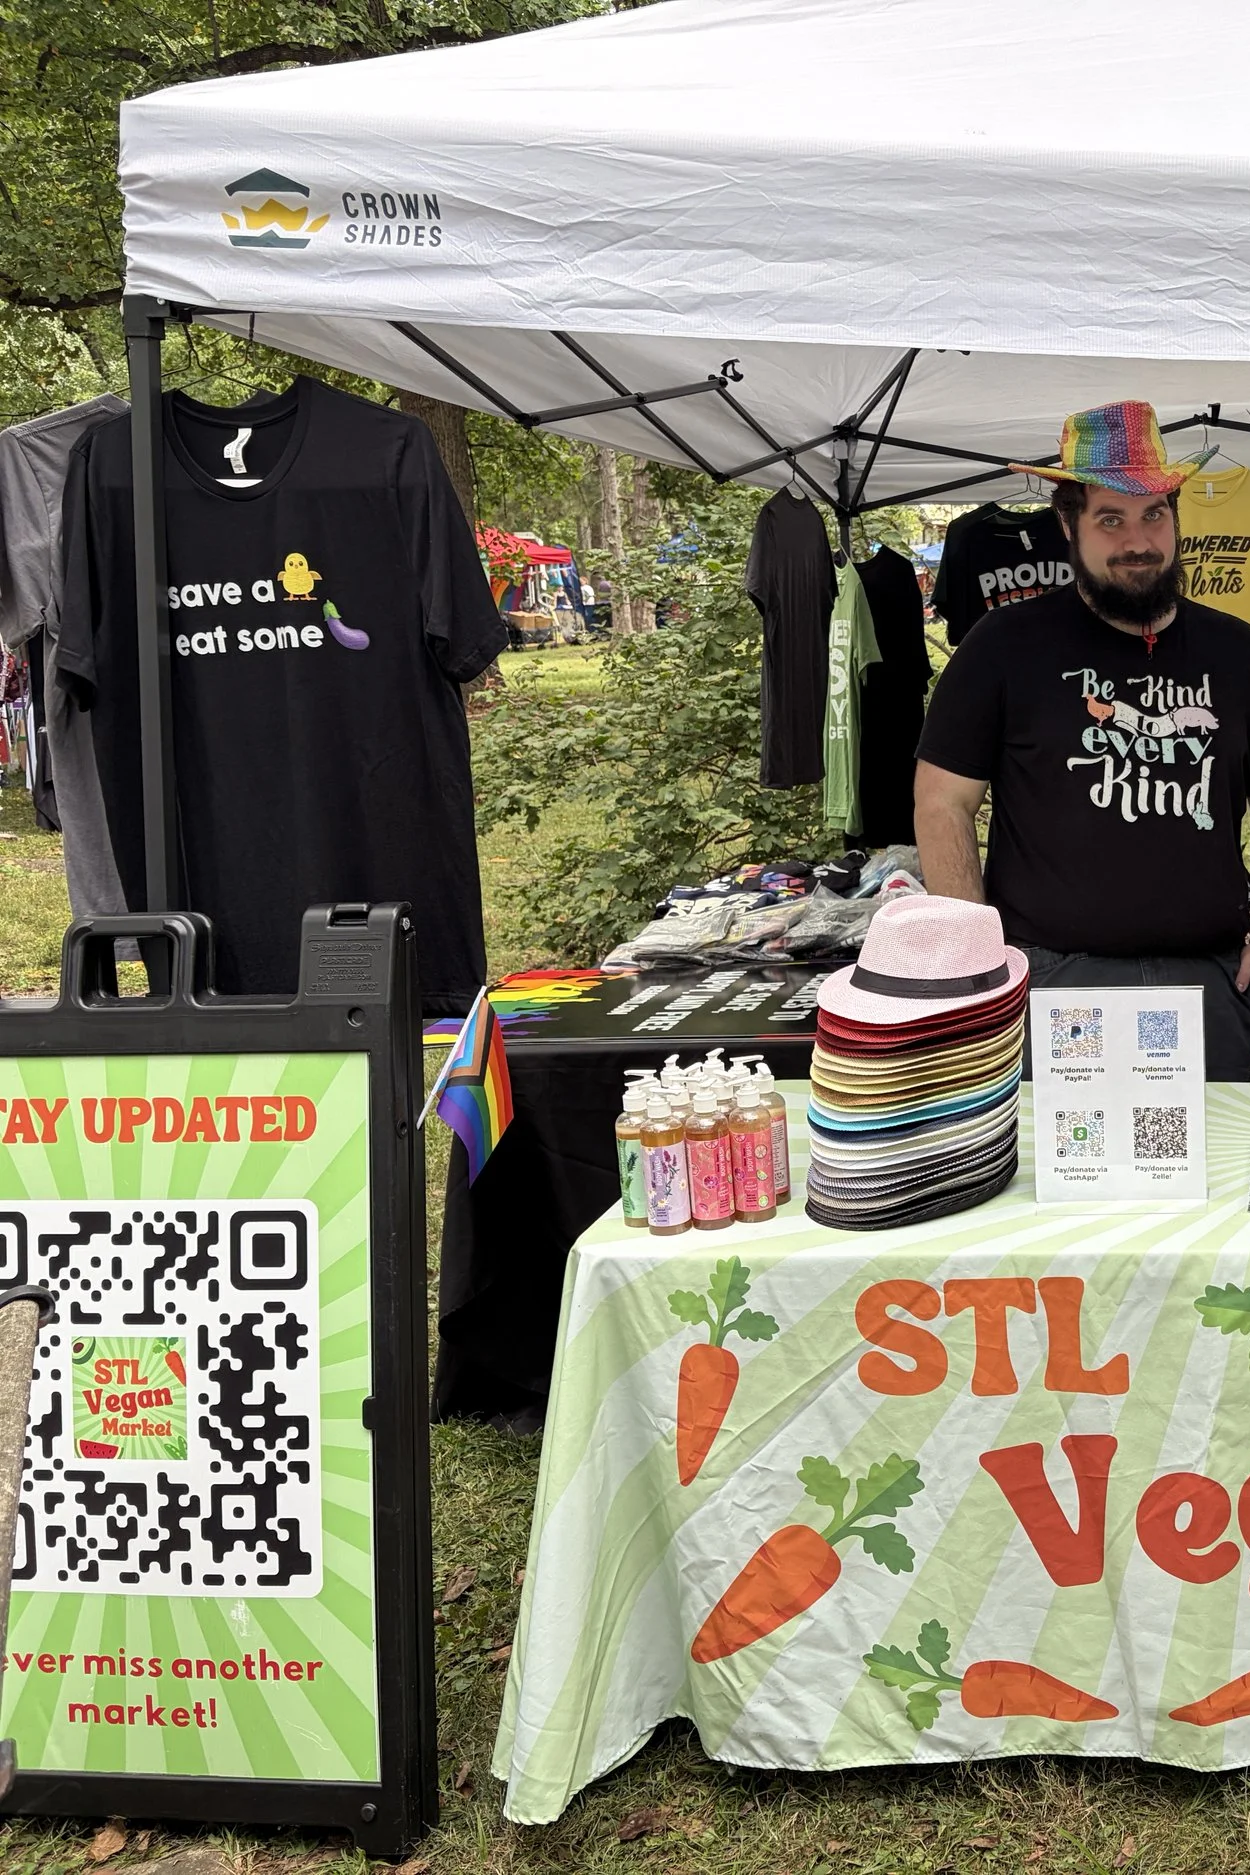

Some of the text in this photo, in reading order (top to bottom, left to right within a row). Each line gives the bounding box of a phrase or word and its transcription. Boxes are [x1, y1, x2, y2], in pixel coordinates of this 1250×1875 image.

[341, 192, 441, 220] CROWN
[344, 223, 442, 247] SHADES
[167, 579, 276, 609] save a
[979, 561, 1075, 598] PROUD
[175, 624, 325, 657] eat some
[1061, 668, 1213, 713] Be Kind
[1137, 716, 1160, 736] to
[1082, 726, 1213, 765] every
[1067, 754, 1215, 823] Kind
[632, 1011, 693, 1032] FREE
[1050, 1067, 1093, 1075] Pay/donate
[1064, 1075, 1092, 1083] PayPal!
[1132, 1066, 1174, 1074] Pay/donate
[0, 1096, 318, 1143] AY UPDATED
[653, 1155, 663, 1186] BODY WASH
[1054, 1166, 1096, 1174] Pay/donate
[1063, 1174, 1099, 1182] CashApp!
[1135, 1165, 1176, 1173] Pay/donate
[855, 1276, 1130, 1397] STL
[94, 1358, 149, 1385] STL
[82, 1387, 174, 1419] Vegan
[102, 1417, 172, 1437] Market
[84, 1648, 163, 1679] miss
[171, 1648, 324, 1681] another
[67, 1694, 218, 1729] market!
